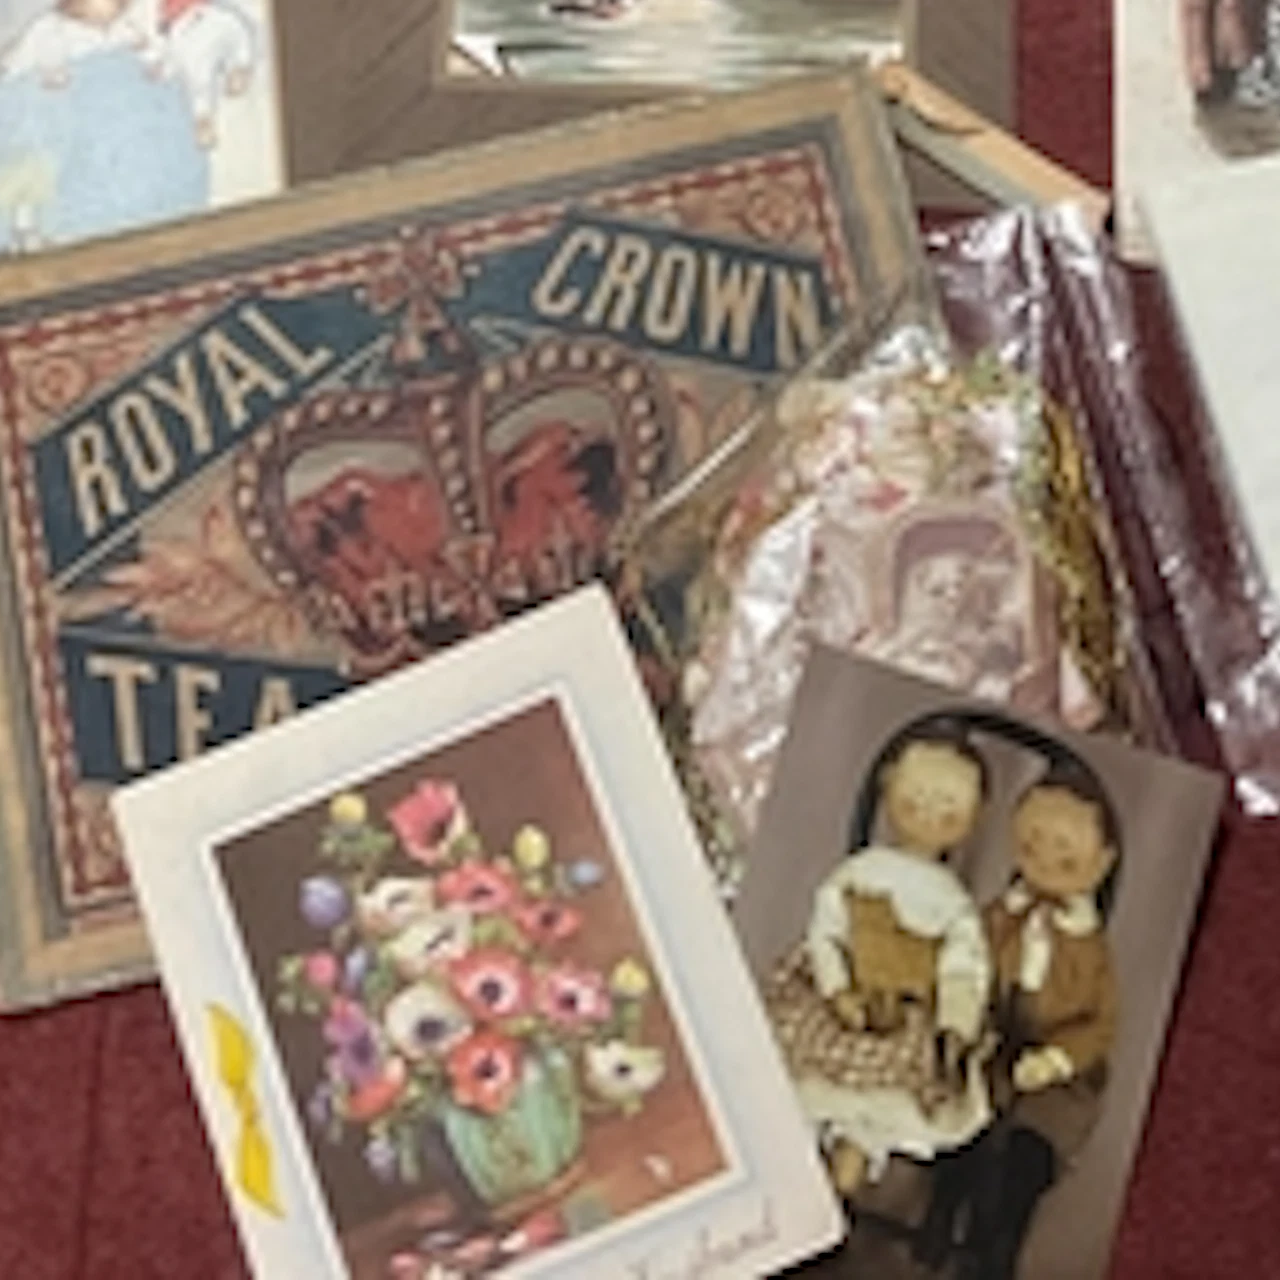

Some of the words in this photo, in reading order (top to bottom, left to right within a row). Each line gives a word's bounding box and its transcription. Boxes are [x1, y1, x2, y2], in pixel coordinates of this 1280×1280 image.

[66, 302, 336, 539] ROYAL
[531, 223, 823, 375] CROWN
[86, 656, 295, 776] TEA
